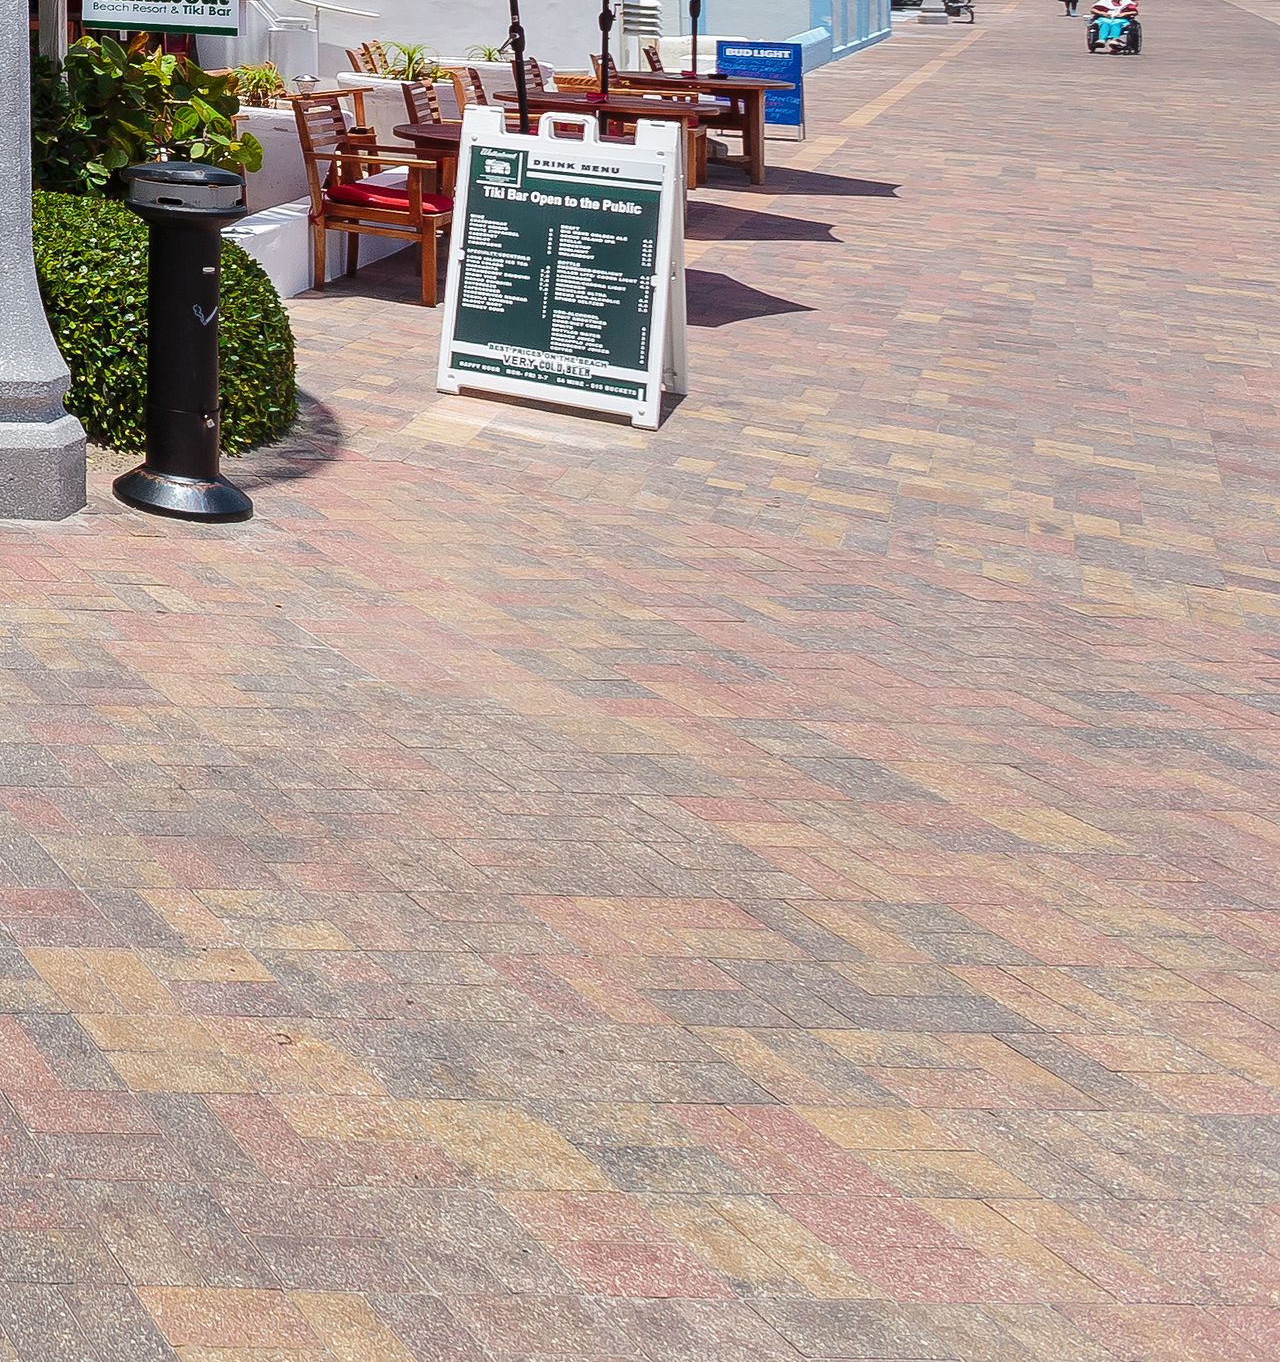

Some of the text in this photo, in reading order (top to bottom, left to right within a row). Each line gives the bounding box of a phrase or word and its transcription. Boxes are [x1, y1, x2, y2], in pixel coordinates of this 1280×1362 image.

[93, 2, 231, 17] Beach Resort & Tiki Bar
[725, 48, 791, 58] BUD LIGHT
[533, 159, 621, 174] DRINK MENU
[483, 185, 643, 216] Tiki Bar Open to the Public
[488, 343, 508, 352] BEST
[511, 347, 541, 357] PRICES
[558, 355, 575, 363] THE
[578, 358, 607, 369] BEACH
[503, 353, 590, 378] VERY COLD BEER
